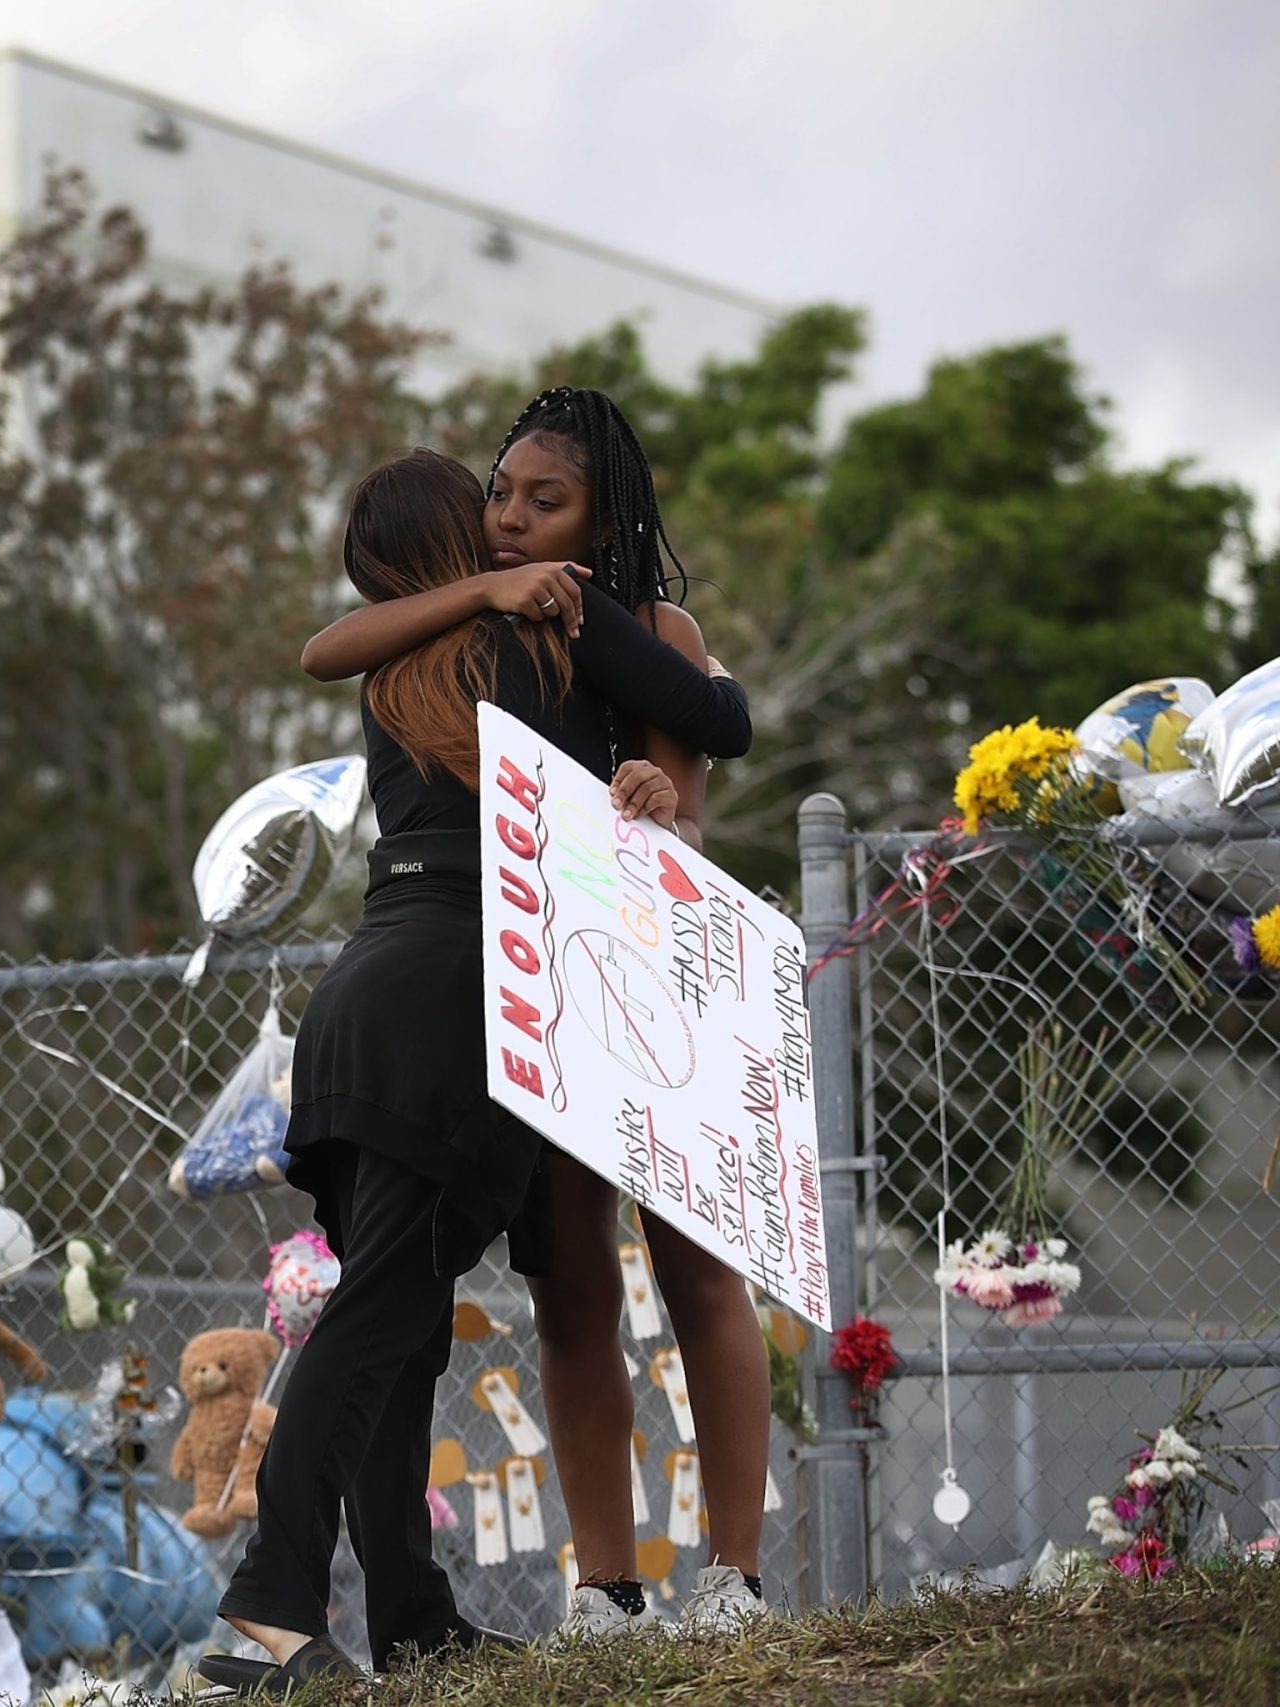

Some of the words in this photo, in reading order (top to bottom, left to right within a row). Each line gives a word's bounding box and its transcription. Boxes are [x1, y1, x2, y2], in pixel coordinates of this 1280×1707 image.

[390, 861, 424, 874] VERSACE
[555, 799, 616, 911] NO
[496, 755, 544, 1099] ENOUGH
[669, 901, 708, 1018] #MSD
[691, 1184, 716, 1225] be
